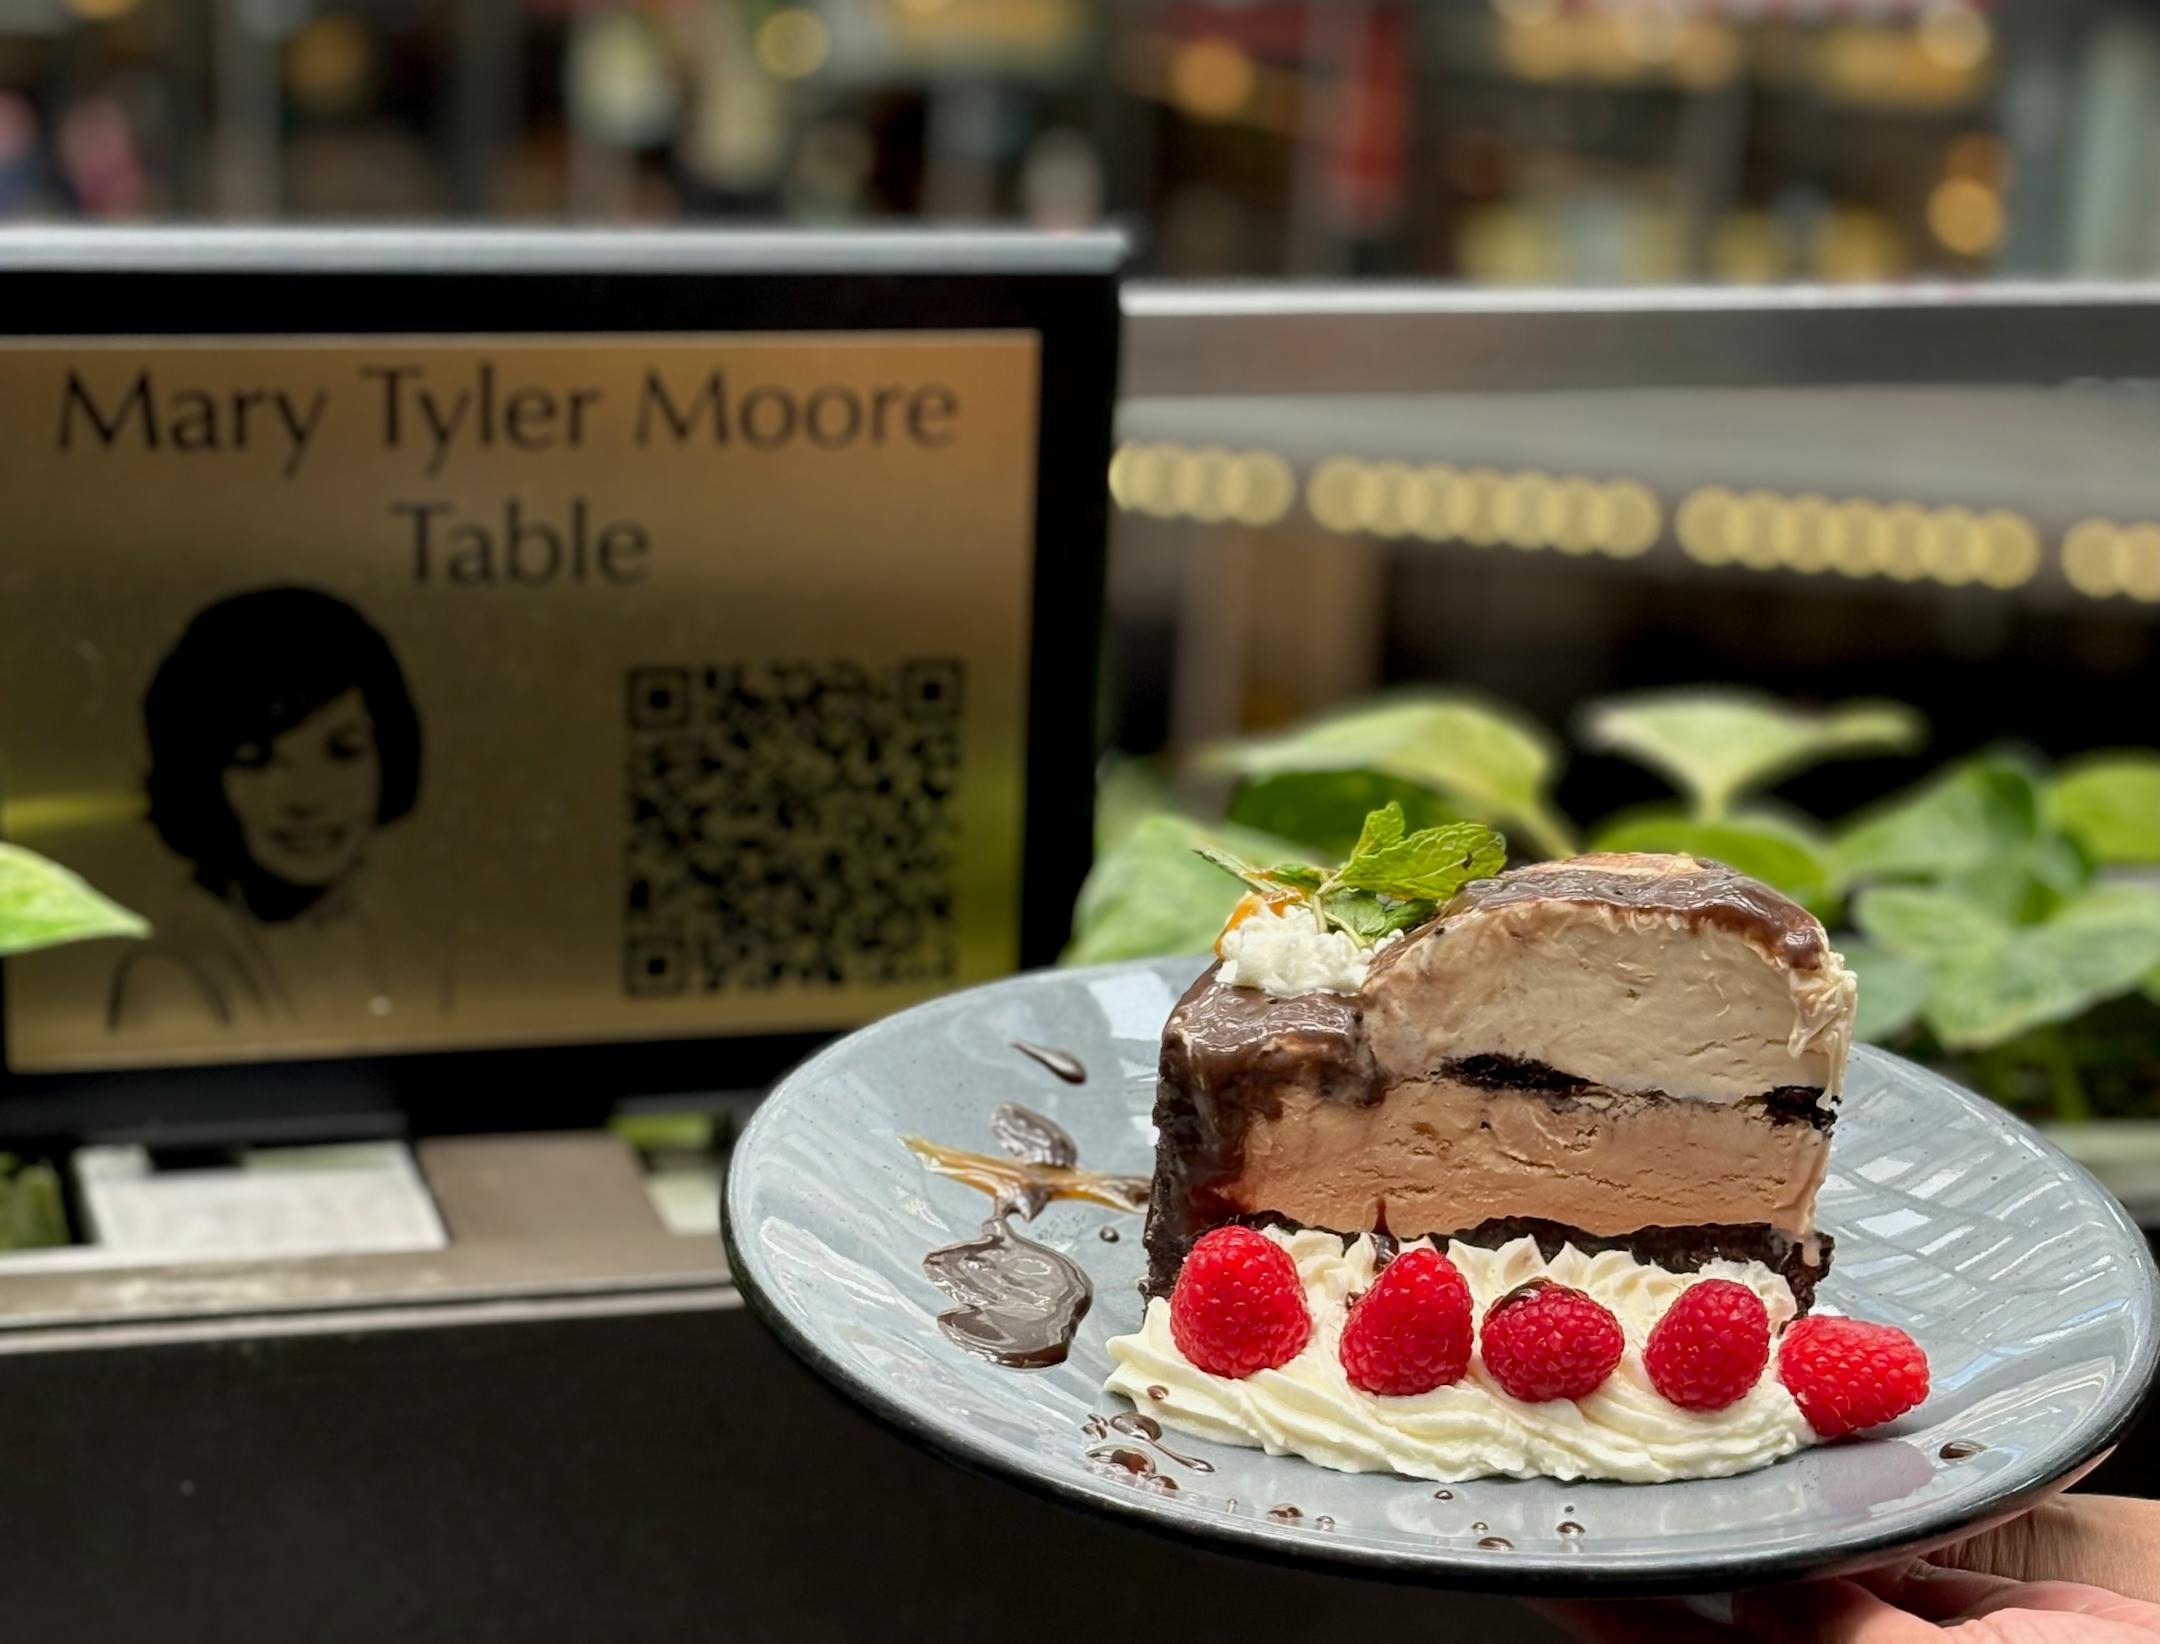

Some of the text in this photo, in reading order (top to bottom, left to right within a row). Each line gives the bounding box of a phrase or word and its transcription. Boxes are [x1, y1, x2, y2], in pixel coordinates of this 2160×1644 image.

[57, 363, 959, 480] Mary Tyler Moore
[389, 499, 650, 586] Table
